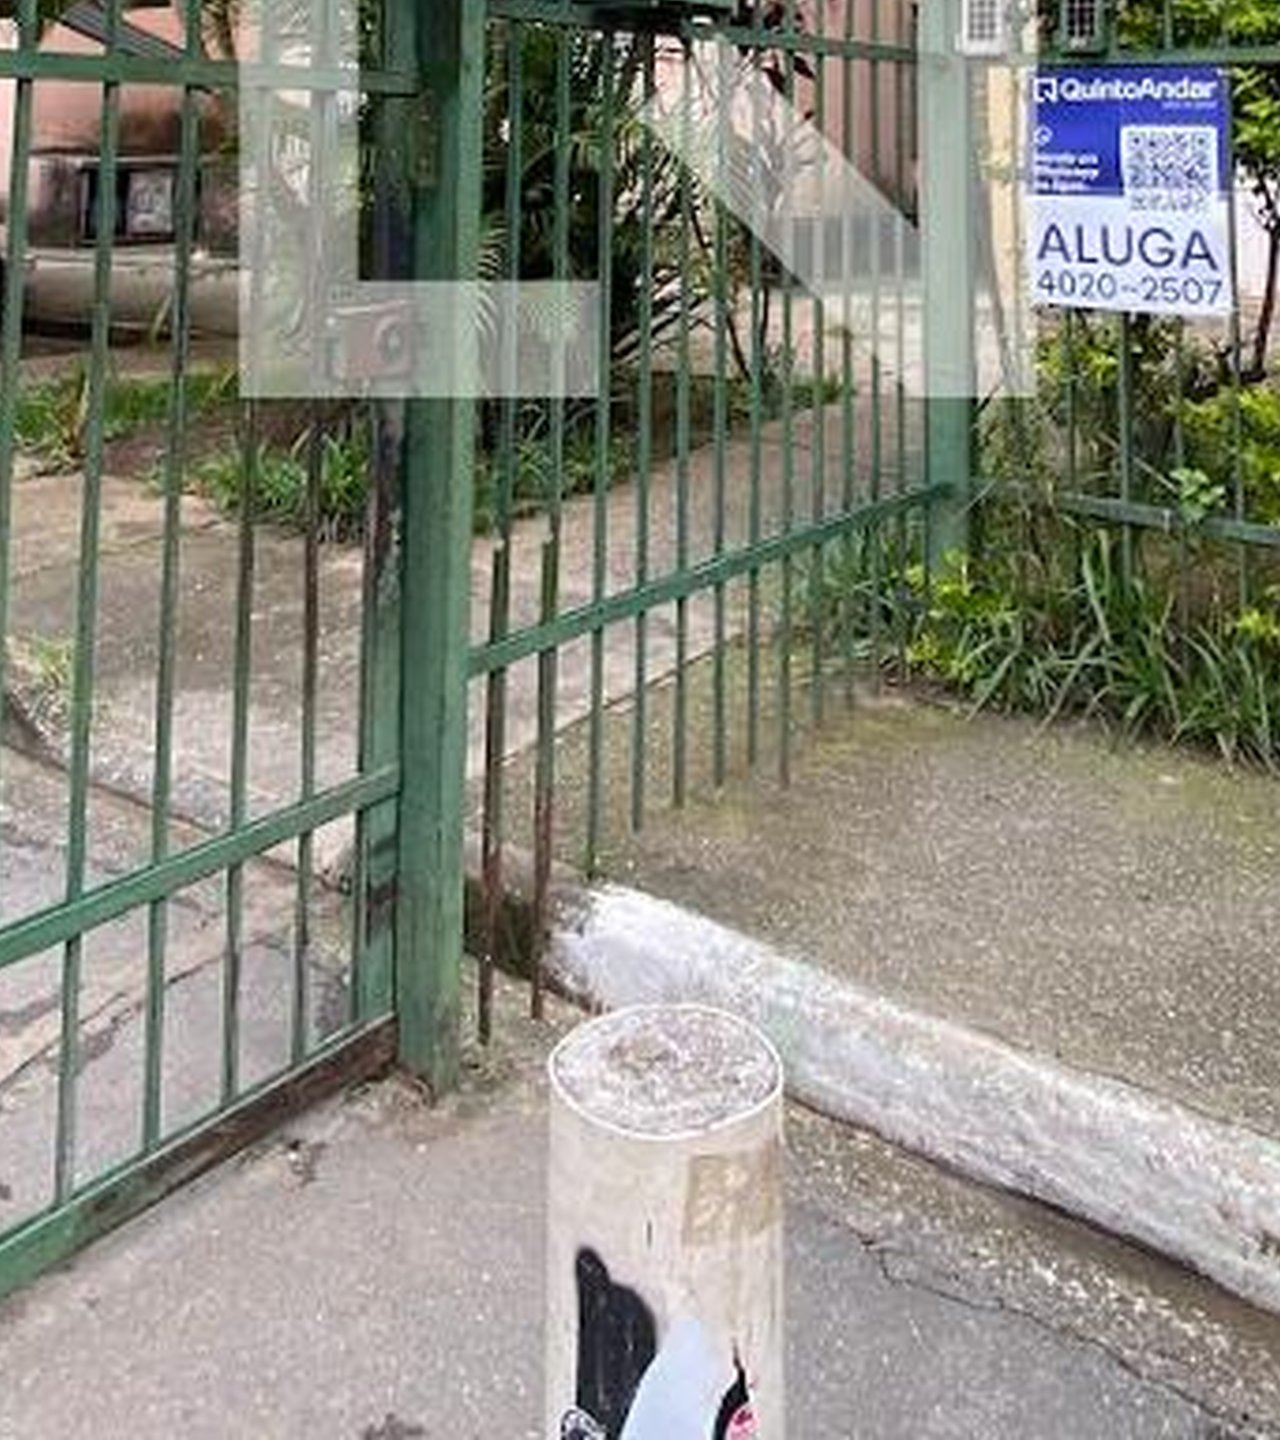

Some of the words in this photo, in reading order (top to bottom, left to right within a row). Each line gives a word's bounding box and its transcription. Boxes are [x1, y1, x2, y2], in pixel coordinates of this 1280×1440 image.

[1060, 75, 1218, 102] QuintoAndar
[1037, 222, 1220, 272] ALUGA
[1037, 269, 1223, 306] 4020-2507
